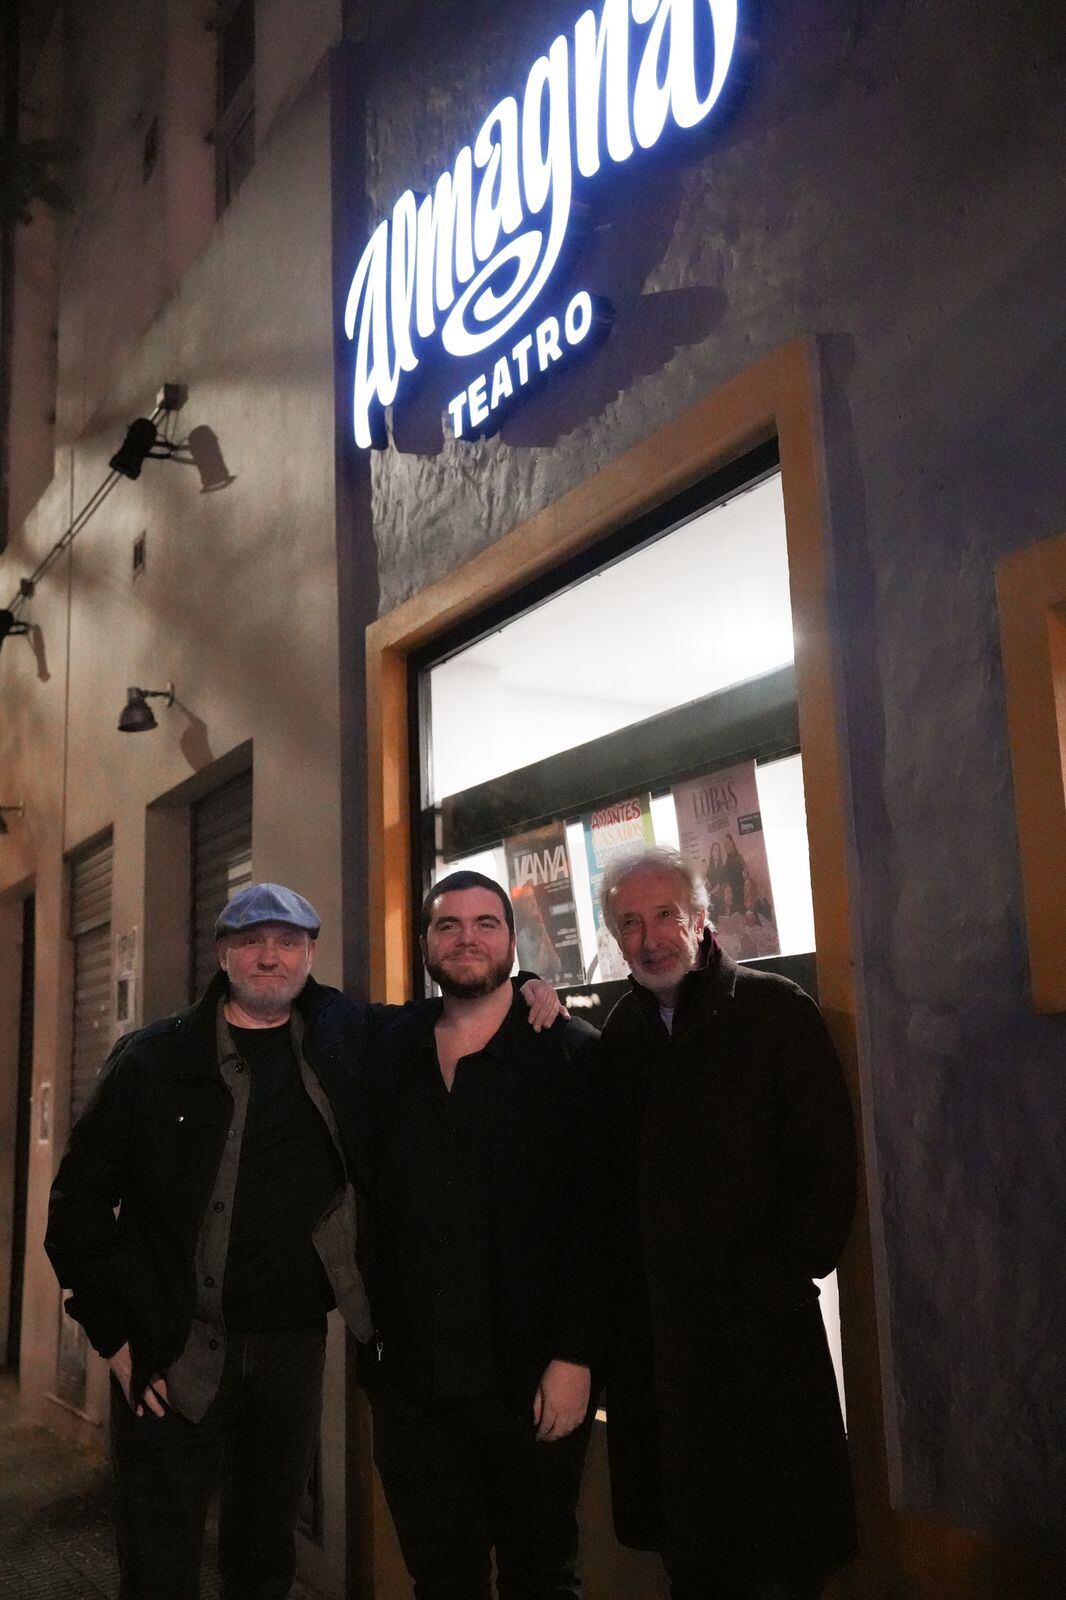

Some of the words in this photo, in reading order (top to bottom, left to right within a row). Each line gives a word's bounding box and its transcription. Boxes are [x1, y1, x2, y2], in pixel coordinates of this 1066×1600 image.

[447, 290, 593, 438] TEATRO
[591, 800, 641, 829] AMANTES
[513, 845, 569, 888] VANYA
